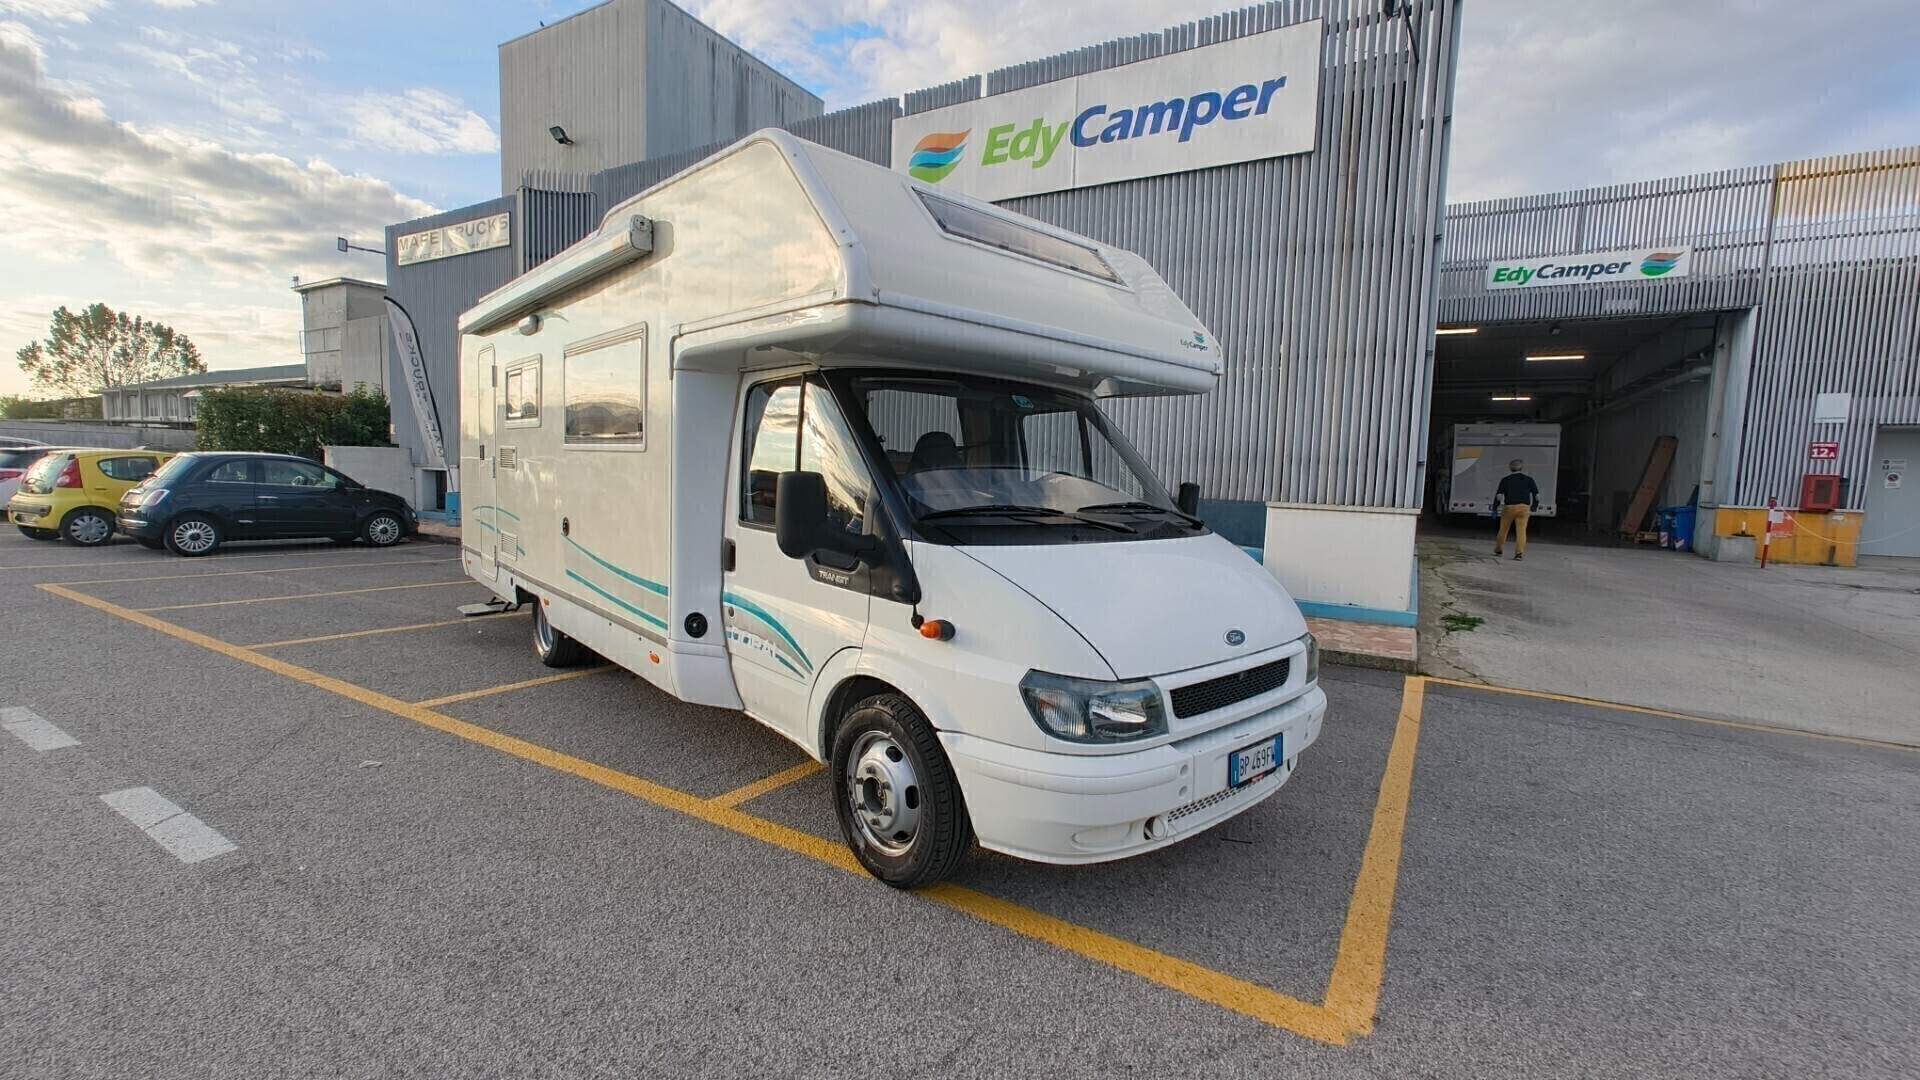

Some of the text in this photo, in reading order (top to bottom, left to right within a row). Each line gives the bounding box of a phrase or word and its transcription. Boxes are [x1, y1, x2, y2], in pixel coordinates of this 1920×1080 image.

[981, 75, 1287, 169] EdyCamper
[398, 215, 508, 251] MAFE RUCKS
[1492, 260, 1631, 285] EdyCamper
[818, 570, 848, 584] TRANSIT
[1239, 756, 1250, 777] BP
